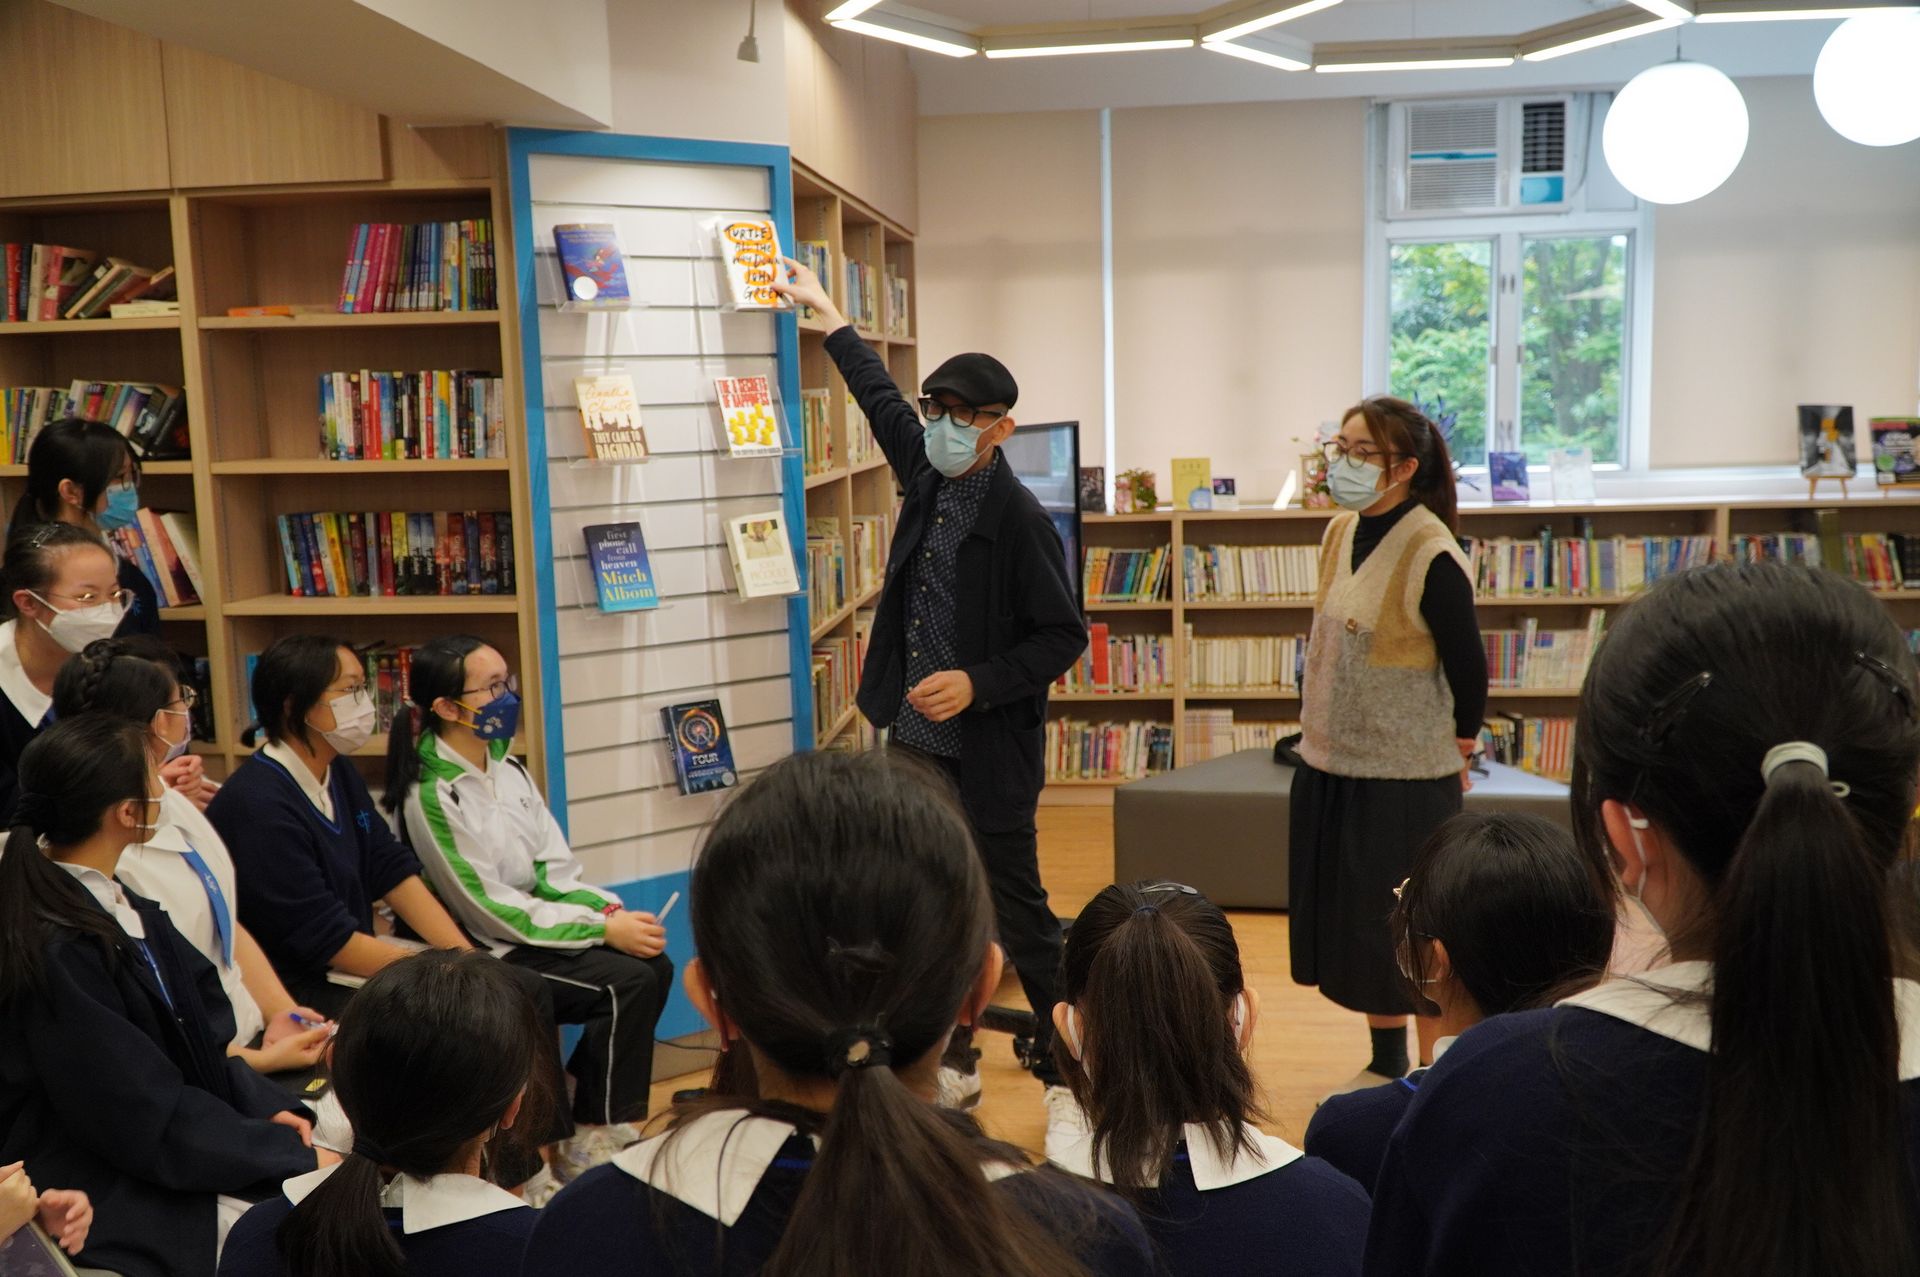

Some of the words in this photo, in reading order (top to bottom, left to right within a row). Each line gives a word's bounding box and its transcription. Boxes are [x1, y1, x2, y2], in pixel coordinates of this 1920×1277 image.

[611, 430, 630, 443] CAME
[630, 429, 642, 442] TO
[595, 442, 645, 460] BAGHDAD
[606, 530, 627, 540] first
[598, 538, 626, 551] phone
[616, 542, 638, 555] call
[601, 560, 638, 570] heaven
[602, 568, 647, 585] Mitch
[605, 586, 654, 602] Albom
[692, 752, 719, 766] FOUR
